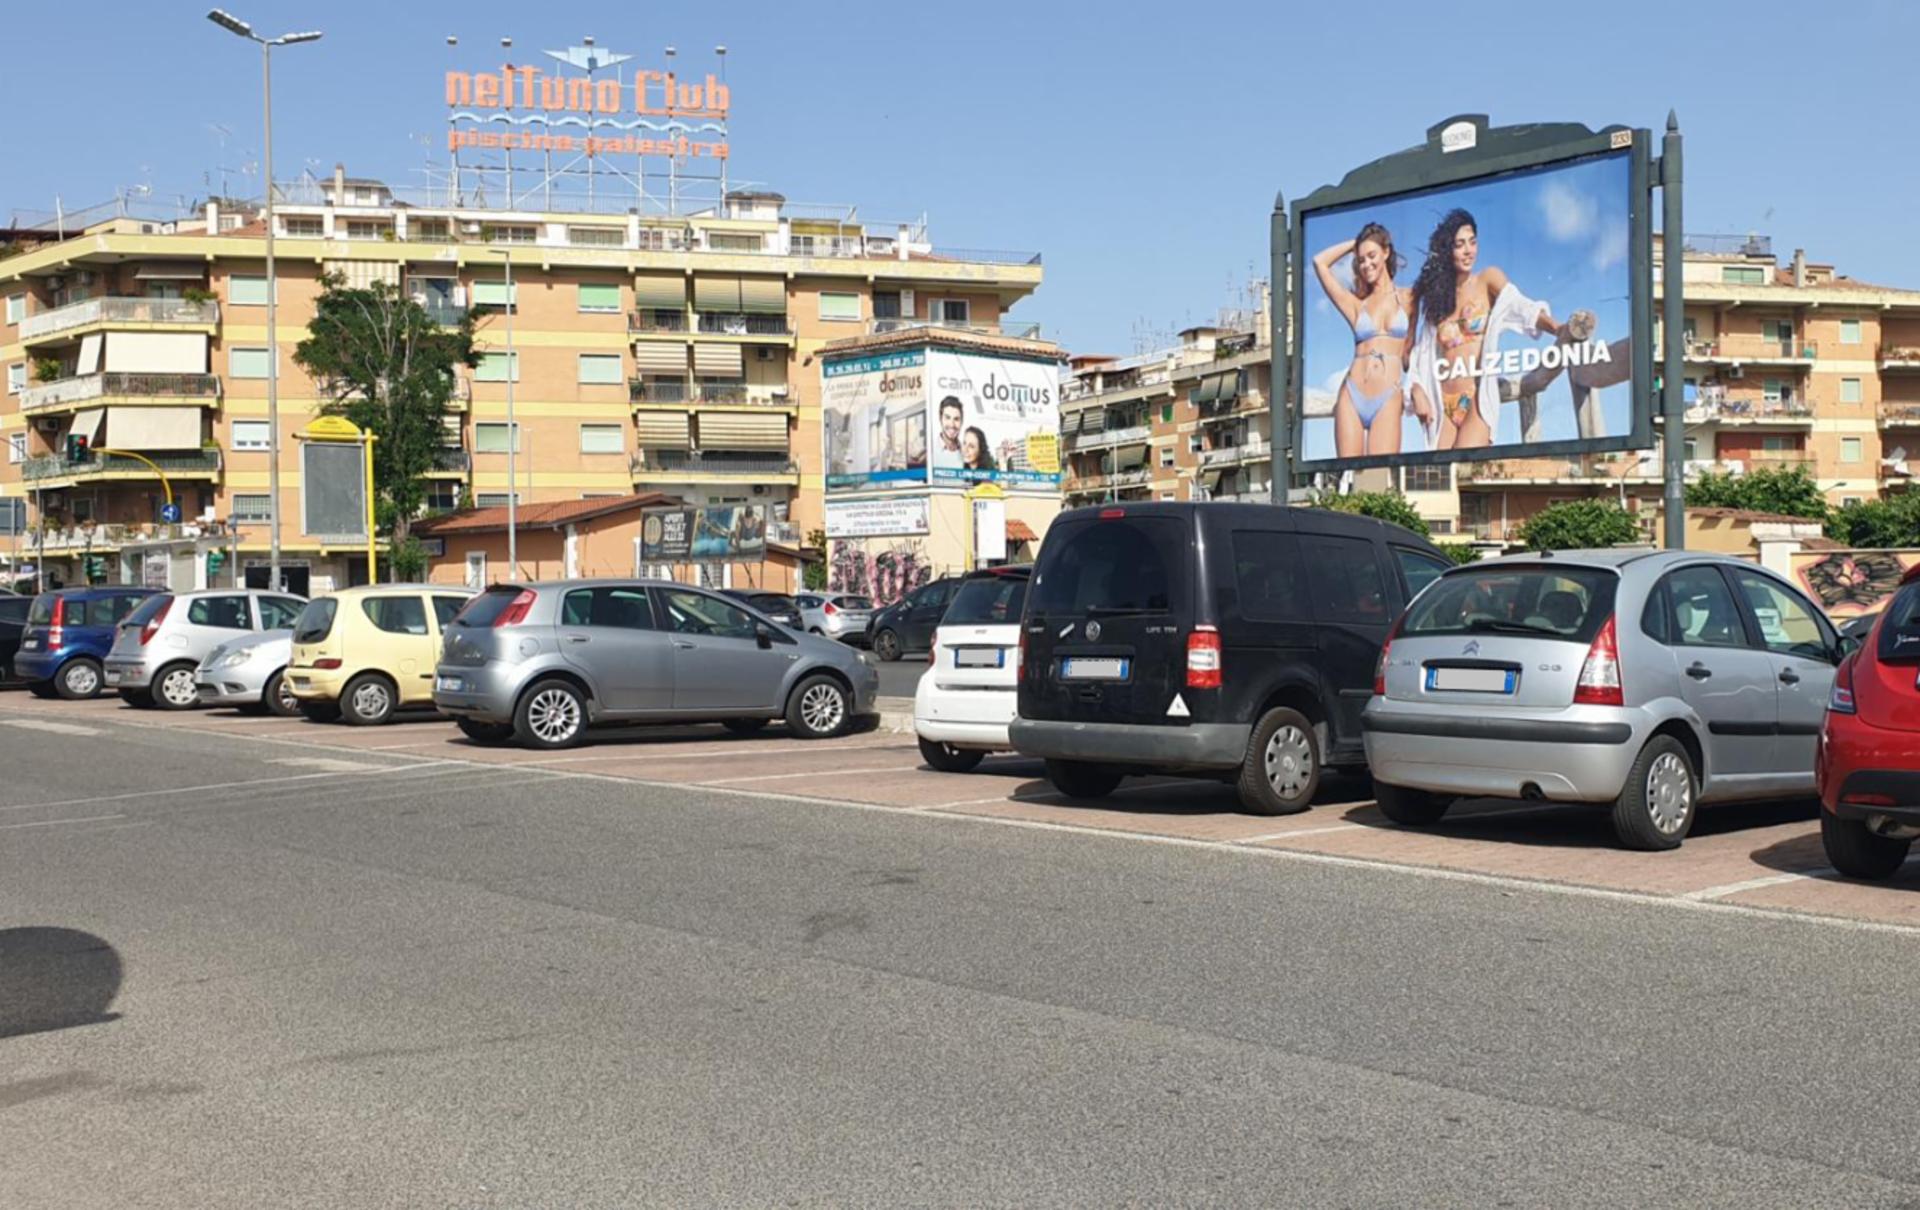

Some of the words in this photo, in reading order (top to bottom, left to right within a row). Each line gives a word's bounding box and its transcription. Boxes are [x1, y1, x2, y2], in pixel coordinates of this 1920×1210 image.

[635, 69, 730, 118] Club
[1433, 338, 1612, 381] CALZEDONIA
[880, 372, 922, 394] domus
[938, 376, 973, 391] cam
[982, 372, 1050, 405] domus
